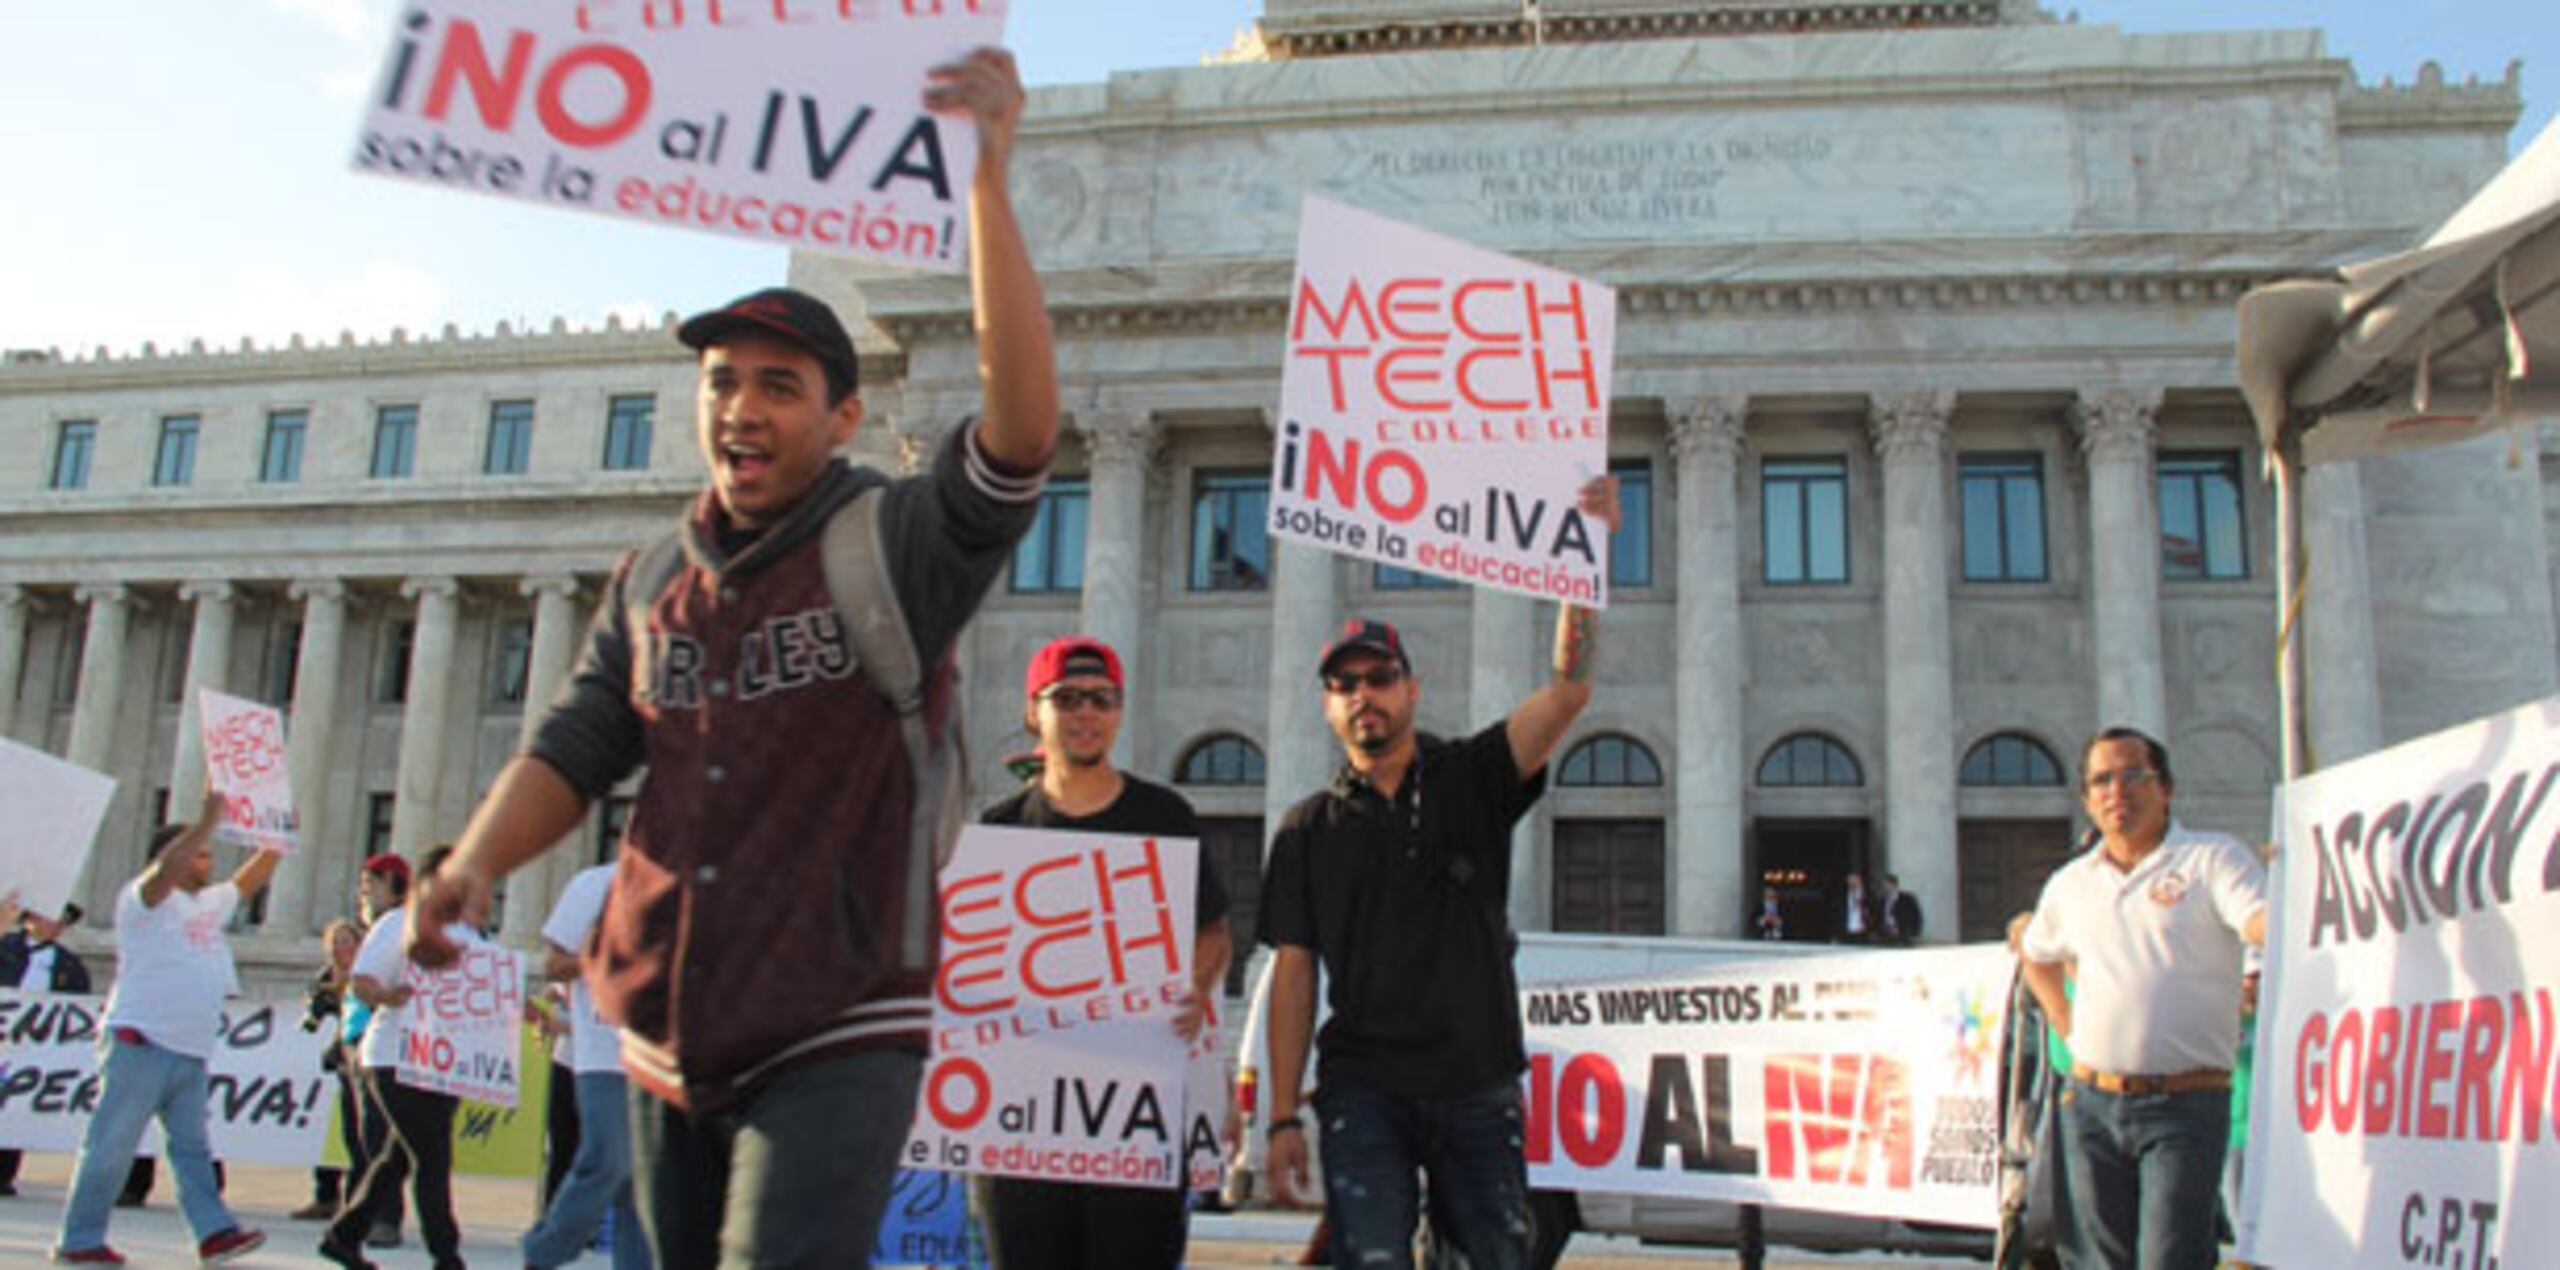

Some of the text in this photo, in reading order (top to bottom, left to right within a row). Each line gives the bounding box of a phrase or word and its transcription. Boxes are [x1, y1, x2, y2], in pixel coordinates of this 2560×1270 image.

[659, 112, 728, 166] al
[752, 89, 953, 202] IVA
[357, 127, 957, 262] sobre la educación!
[1292, 276, 1588, 343] MECH
[1294, 345, 1600, 414] TECH
[1376, 417, 1602, 443] COLLEGE
[1274, 505, 1600, 602] sobre la educación!
[1434, 500, 1470, 537] al
[1485, 486, 1596, 565] IVA
[940, 838, 1168, 944] ECH
[936, 907, 1181, 1017] ECH
[938, 981, 1184, 1053] COLLEGE
[1598, 985, 1761, 1024] IMPUESTOS
[473, 1051, 515, 1085] IVA
[927, 1056, 992, 1132] O
[999, 1098, 1036, 1133] al
[1052, 1078, 1167, 1142] IVA
[2294, 986, 2560, 1146] GOBIERN
[939, 1136, 968, 1168] la
[981, 1142, 1173, 1182] educación!
[1636, 1054, 1759, 1175] AL
[1765, 1054, 1914, 1190] IVA
